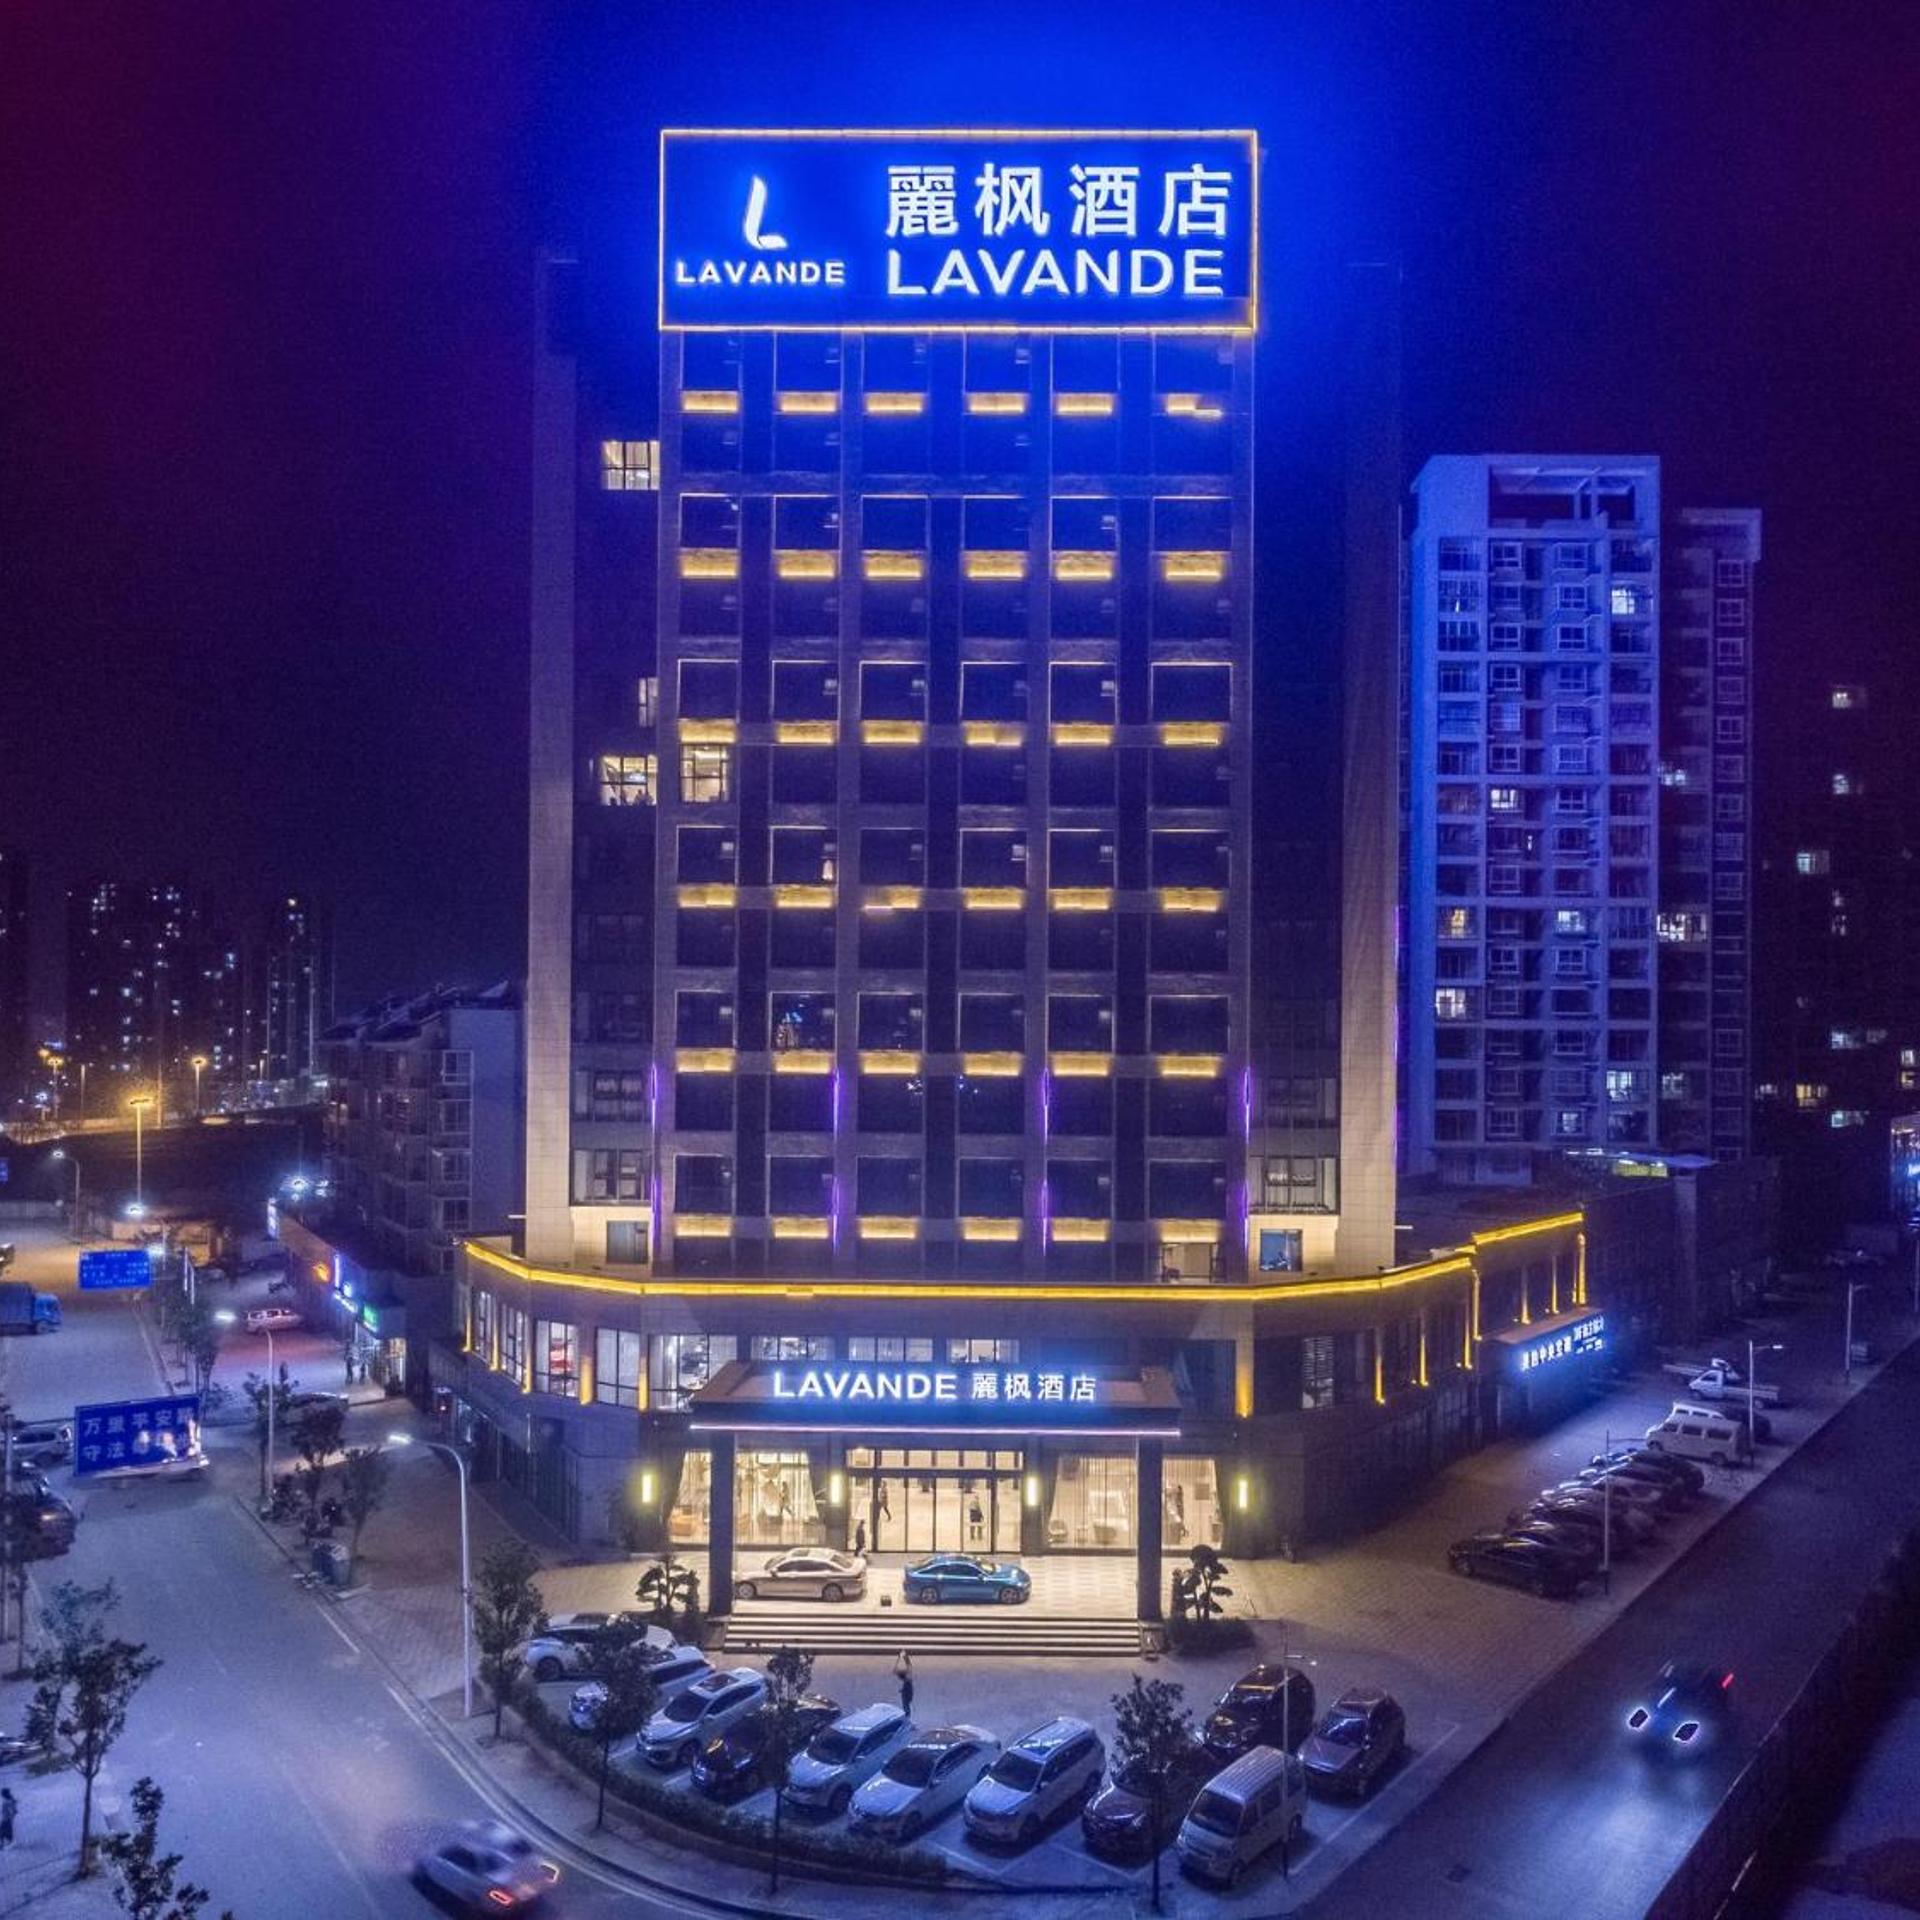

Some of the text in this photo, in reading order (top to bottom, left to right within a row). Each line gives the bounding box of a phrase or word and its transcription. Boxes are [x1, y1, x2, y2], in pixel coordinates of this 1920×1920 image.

[886, 163, 1232, 237] 麗枫酒店
[675, 260, 845, 285] LAVANDE
[888, 248, 1224, 295] LAVANDE
[773, 1371, 1096, 1402] LAVANDE 麗枫酒店
